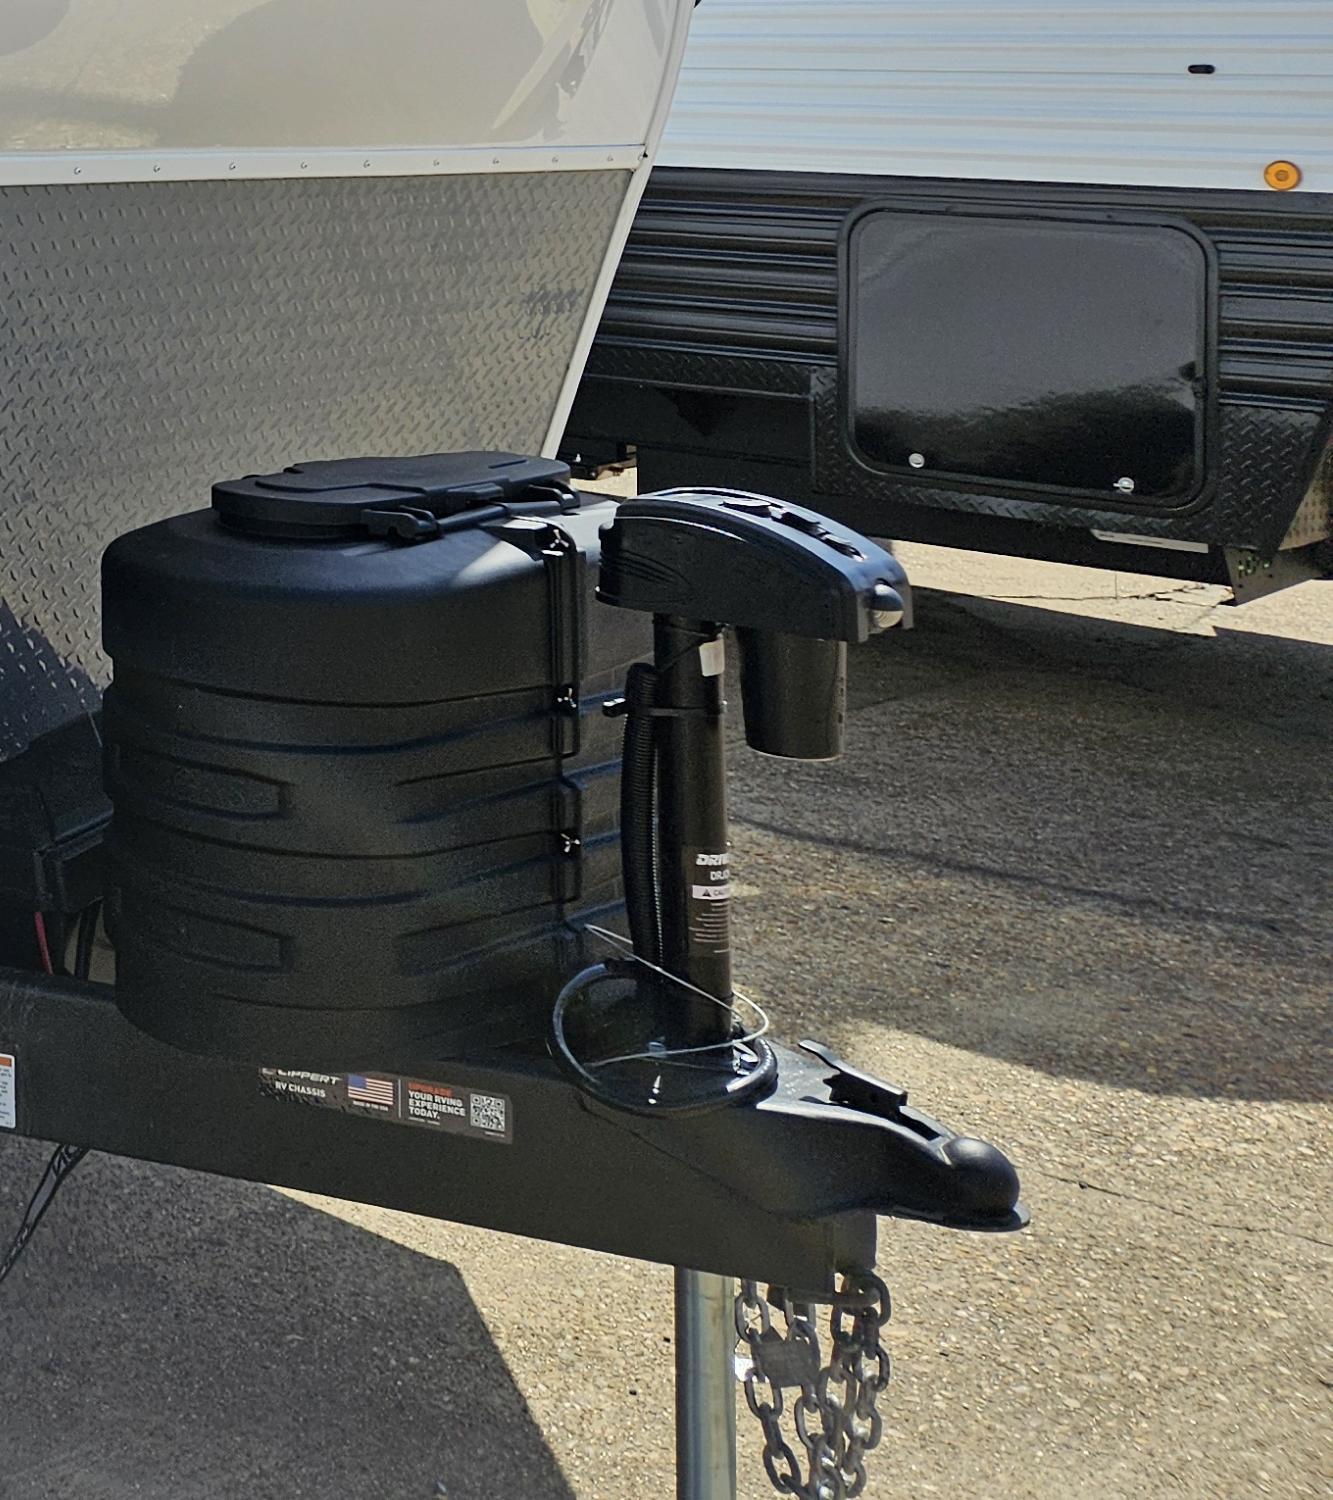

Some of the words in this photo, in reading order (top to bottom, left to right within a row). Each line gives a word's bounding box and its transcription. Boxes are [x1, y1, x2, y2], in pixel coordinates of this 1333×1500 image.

[274, 1080, 288, 1091] RV
[288, 1081, 327, 1099] CHASSIS
[408, 1089, 434, 1103] YOUR
[434, 1094, 463, 1108] RVING
[408, 1098, 466, 1117] EXPERIENCE
[408, 1106, 441, 1120] TODAY.
